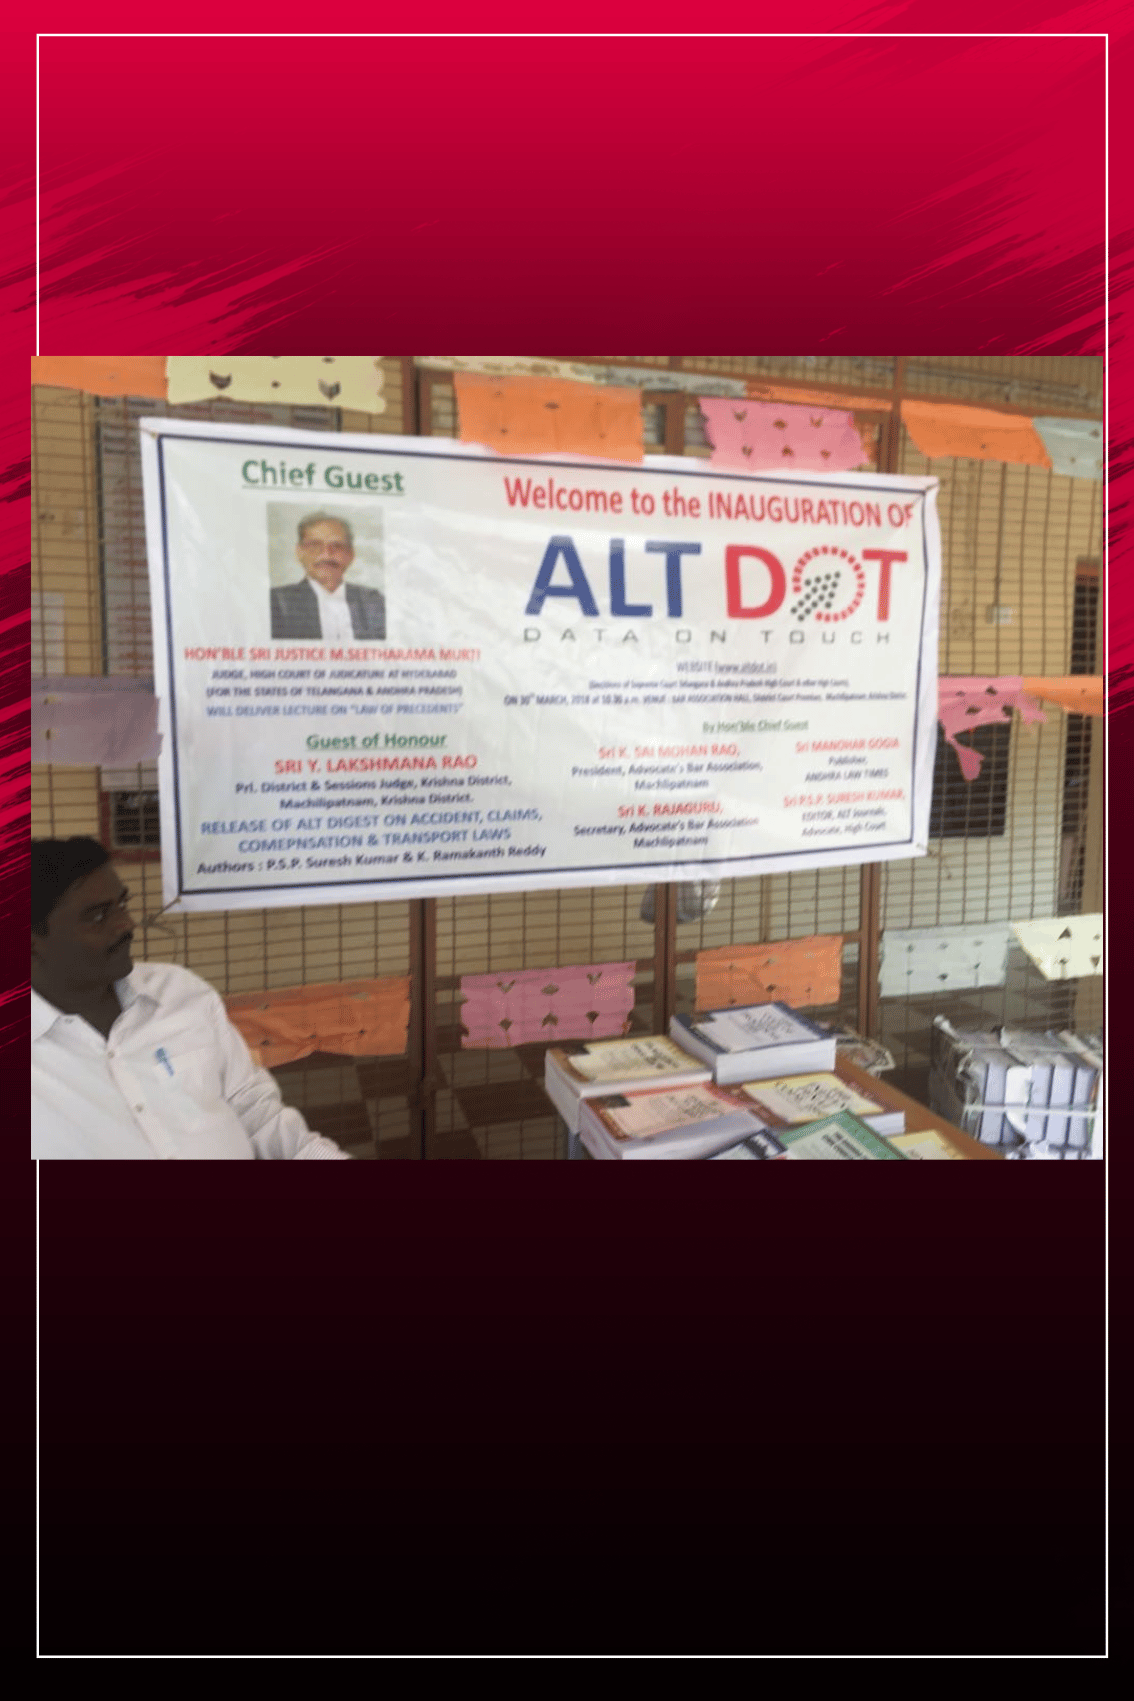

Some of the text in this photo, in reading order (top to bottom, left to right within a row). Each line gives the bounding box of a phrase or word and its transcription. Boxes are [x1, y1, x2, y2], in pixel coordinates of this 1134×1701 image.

[241, 459, 405, 495] Chief Guest
[504, 476, 914, 529] Welcome to the INAUGURATION OF
[524, 534, 703, 618] ALT
[523, 627, 891, 646] DATA ON TOUCH
[249, 648, 270, 661] SRI
[274, 647, 325, 662] JUSTICE
[249, 669, 276, 680] HIGH
[278, 669, 311, 680] COURT
[313, 669, 326, 680] OF
[328, 669, 384, 680] JUDICATURE
[388, 669, 400, 680] AT
[676, 660, 712, 673] WEBSITE
[234, 687, 250, 698] THE
[254, 687, 288, 698] STATES
[290, 686, 304, 698] OF
[305, 686, 364, 698] TELANGANA
[366, 686, 373, 697] &
[376, 686, 415, 697] ANDHRA
[504, 695, 518, 707] ON
[206, 706, 232, 718] WILL
[235, 705, 280, 717] DELIVER
[282, 704, 328, 716] LECTURE
[330, 704, 348, 716] ON
[380, 703, 395, 715] OF
[306, 731, 448, 751] Guest of Honour
[598, 745, 617, 759] Sri
[634, 745, 655, 758] SAI
[657, 744, 708, 757] MOHAN
[274, 754, 479, 775] SRI Y. LAKSHMANA RAO
[571, 766, 627, 778] President,
[686, 763, 704, 774] Bar
[706, 761, 764, 773] Association,
[235, 774, 513, 795] Prl. District & Sessions Judge, Krishna District,
[804, 771, 843, 783] ANDHRA
[844, 770, 863, 781] LAW
[380, 795, 426, 807] Krishna
[428, 792, 475, 805] District.
[617, 800, 724, 819] Sri K. RAJAGURU,
[201, 807, 543, 836] RELEASE OF ALT DIGEST ON ACCIDENT, CLAIMS,
[573, 824, 627, 837] Secretary,
[687, 819, 705, 831] Bar
[706, 817, 760, 830] Association
[367, 832, 379, 848] &
[382, 829, 470, 846] TRANSPORT
[472, 827, 512, 843] LAWS
[196, 861, 255, 875] Authors
[266, 857, 303, 872] P.S.P.
[305, 855, 353, 869] Suresh
[355, 853, 400, 866] Kumar
[402, 850, 413, 864] &
[416, 849, 430, 862] K.
[432, 846, 506, 861] Ramakanth
[507, 843, 548, 859] Reddy
